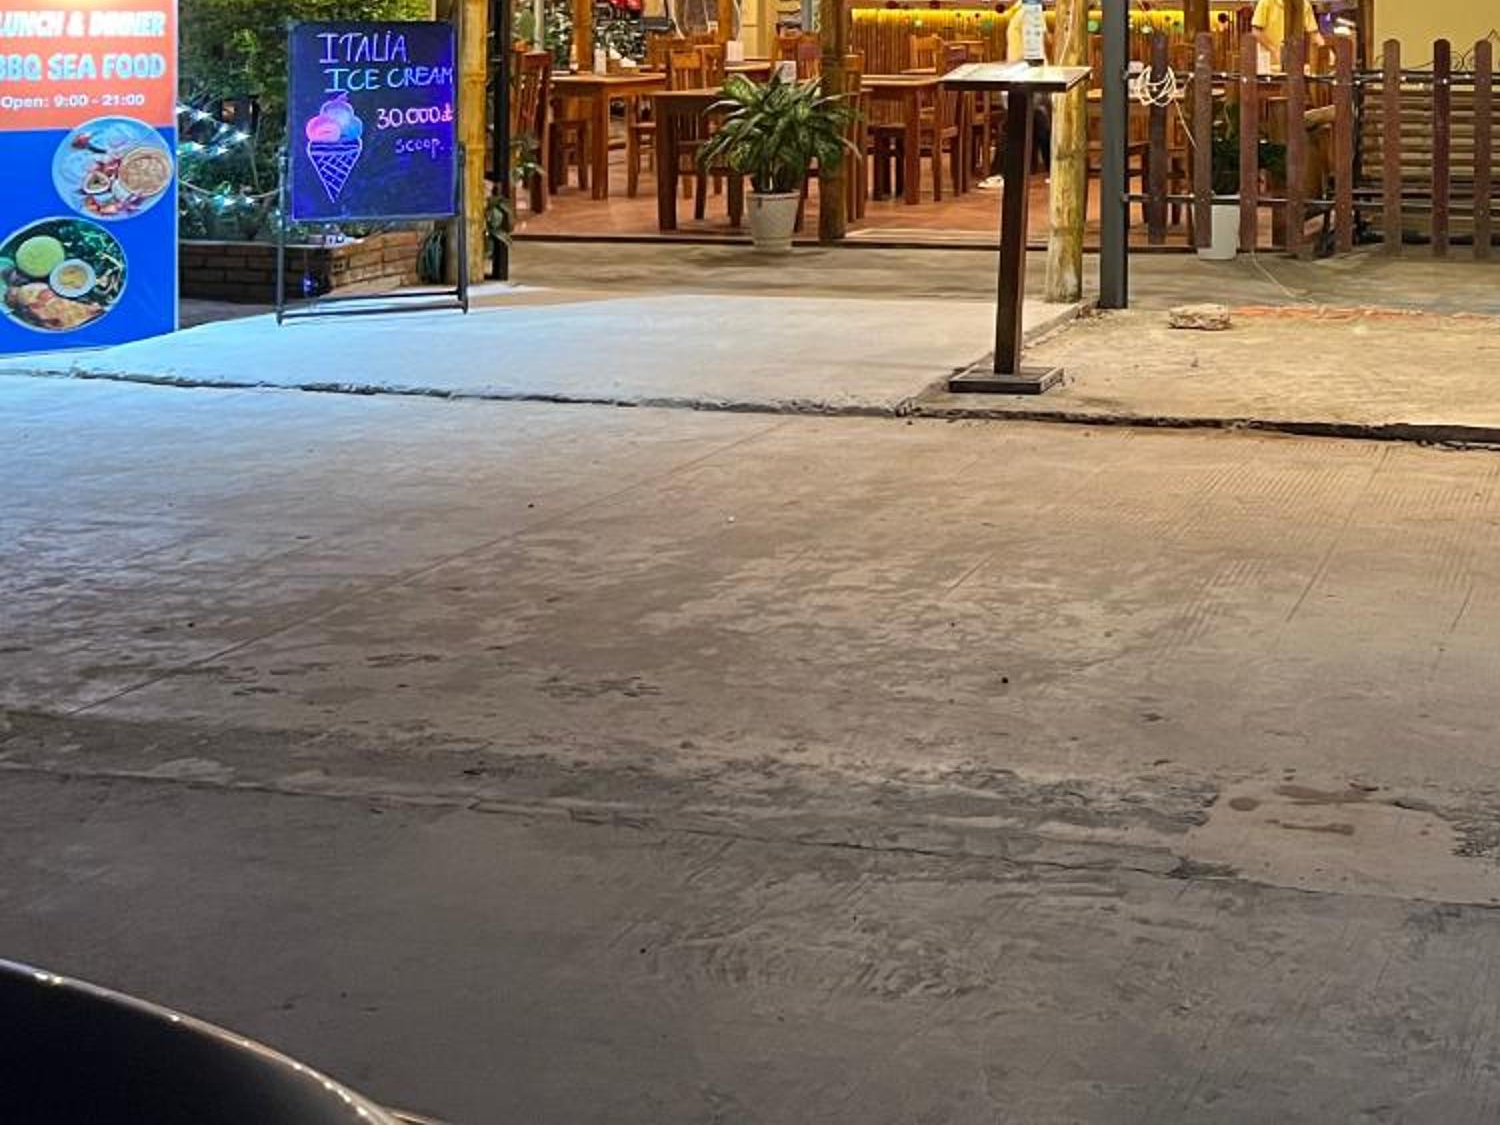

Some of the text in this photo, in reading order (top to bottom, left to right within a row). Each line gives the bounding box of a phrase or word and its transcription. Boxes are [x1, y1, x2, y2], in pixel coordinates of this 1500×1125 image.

[47, 52, 98, 81] SEA
[102, 51, 167, 80] FOOD
[323, 66, 454, 93] ICE CREAM
[1, 95, 50, 112] Open:
[54, 93, 89, 108] 9:00
[101, 93, 145, 107] 21:00
